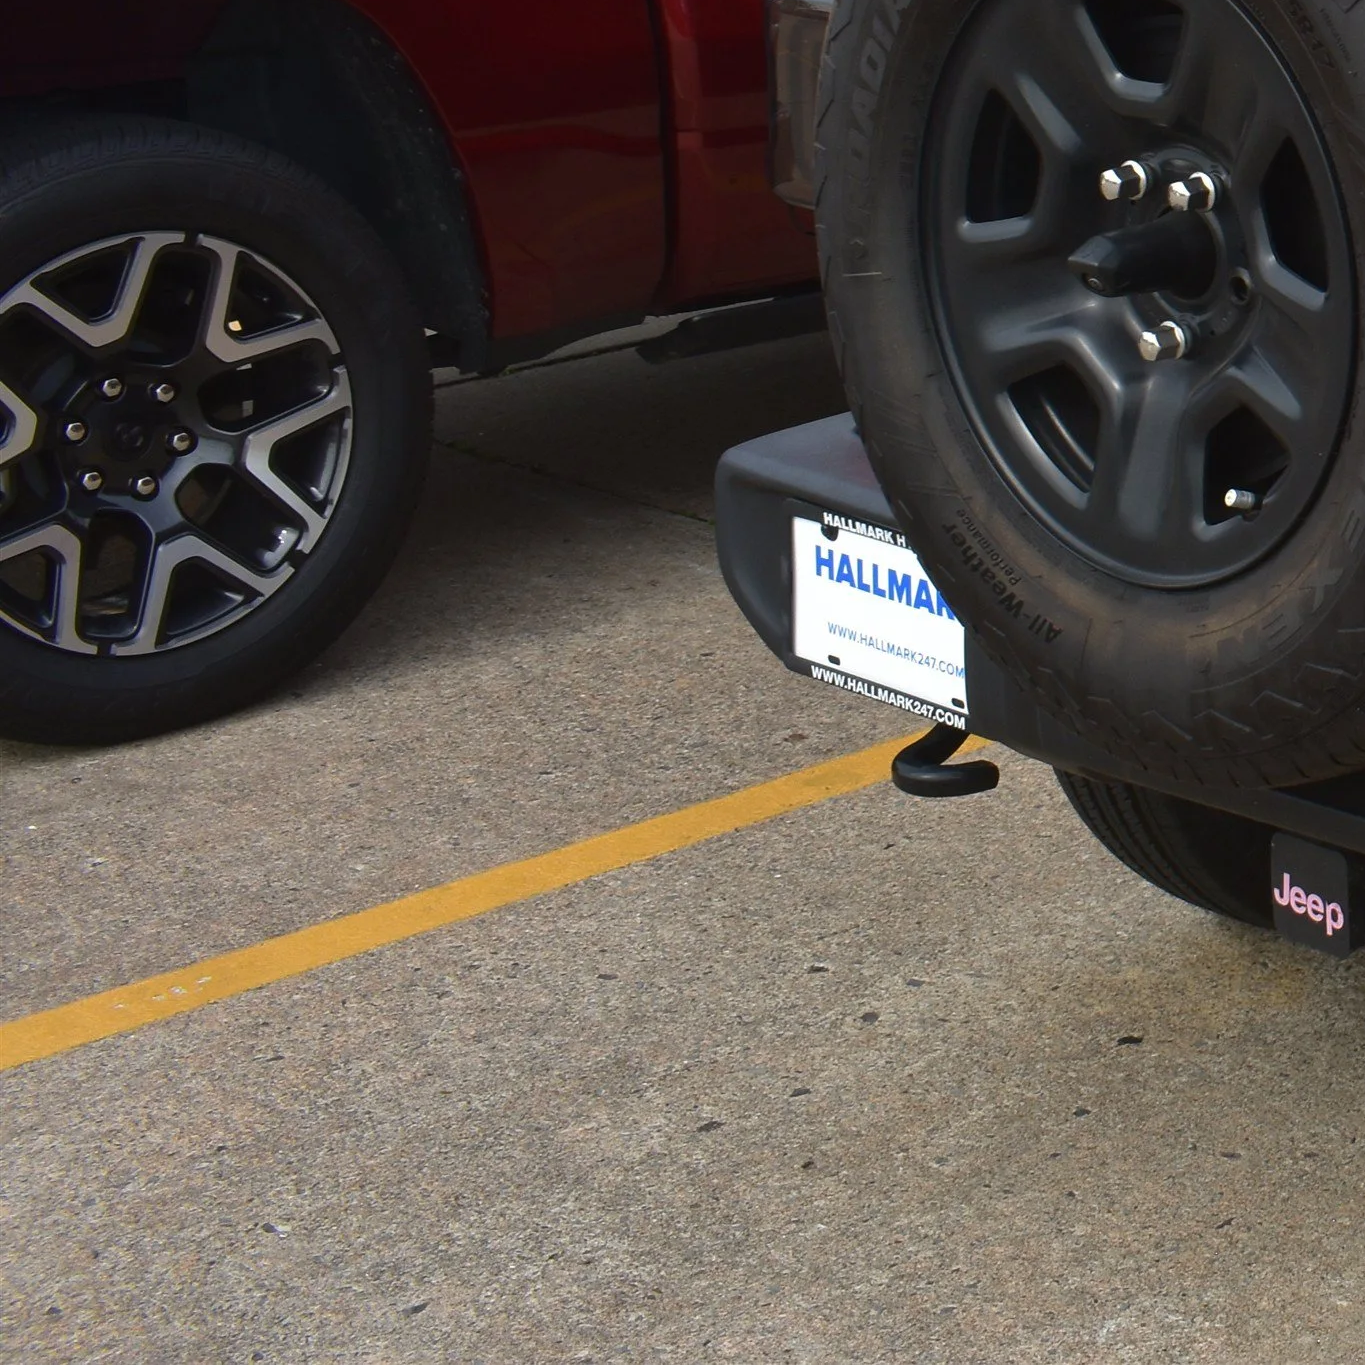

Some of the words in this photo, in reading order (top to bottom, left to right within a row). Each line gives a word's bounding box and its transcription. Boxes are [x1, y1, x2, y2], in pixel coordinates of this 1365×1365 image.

[823, 511, 894, 544] HALLMARK
[956, 508, 1022, 586] Performance
[942, 523, 1064, 644] All-Weather
[827, 621, 965, 679] WWW.HALLMARK247.COM
[810, 665, 966, 731] WWW.HALLMARK247.COM
[1273, 872, 1345, 936] Jeep
